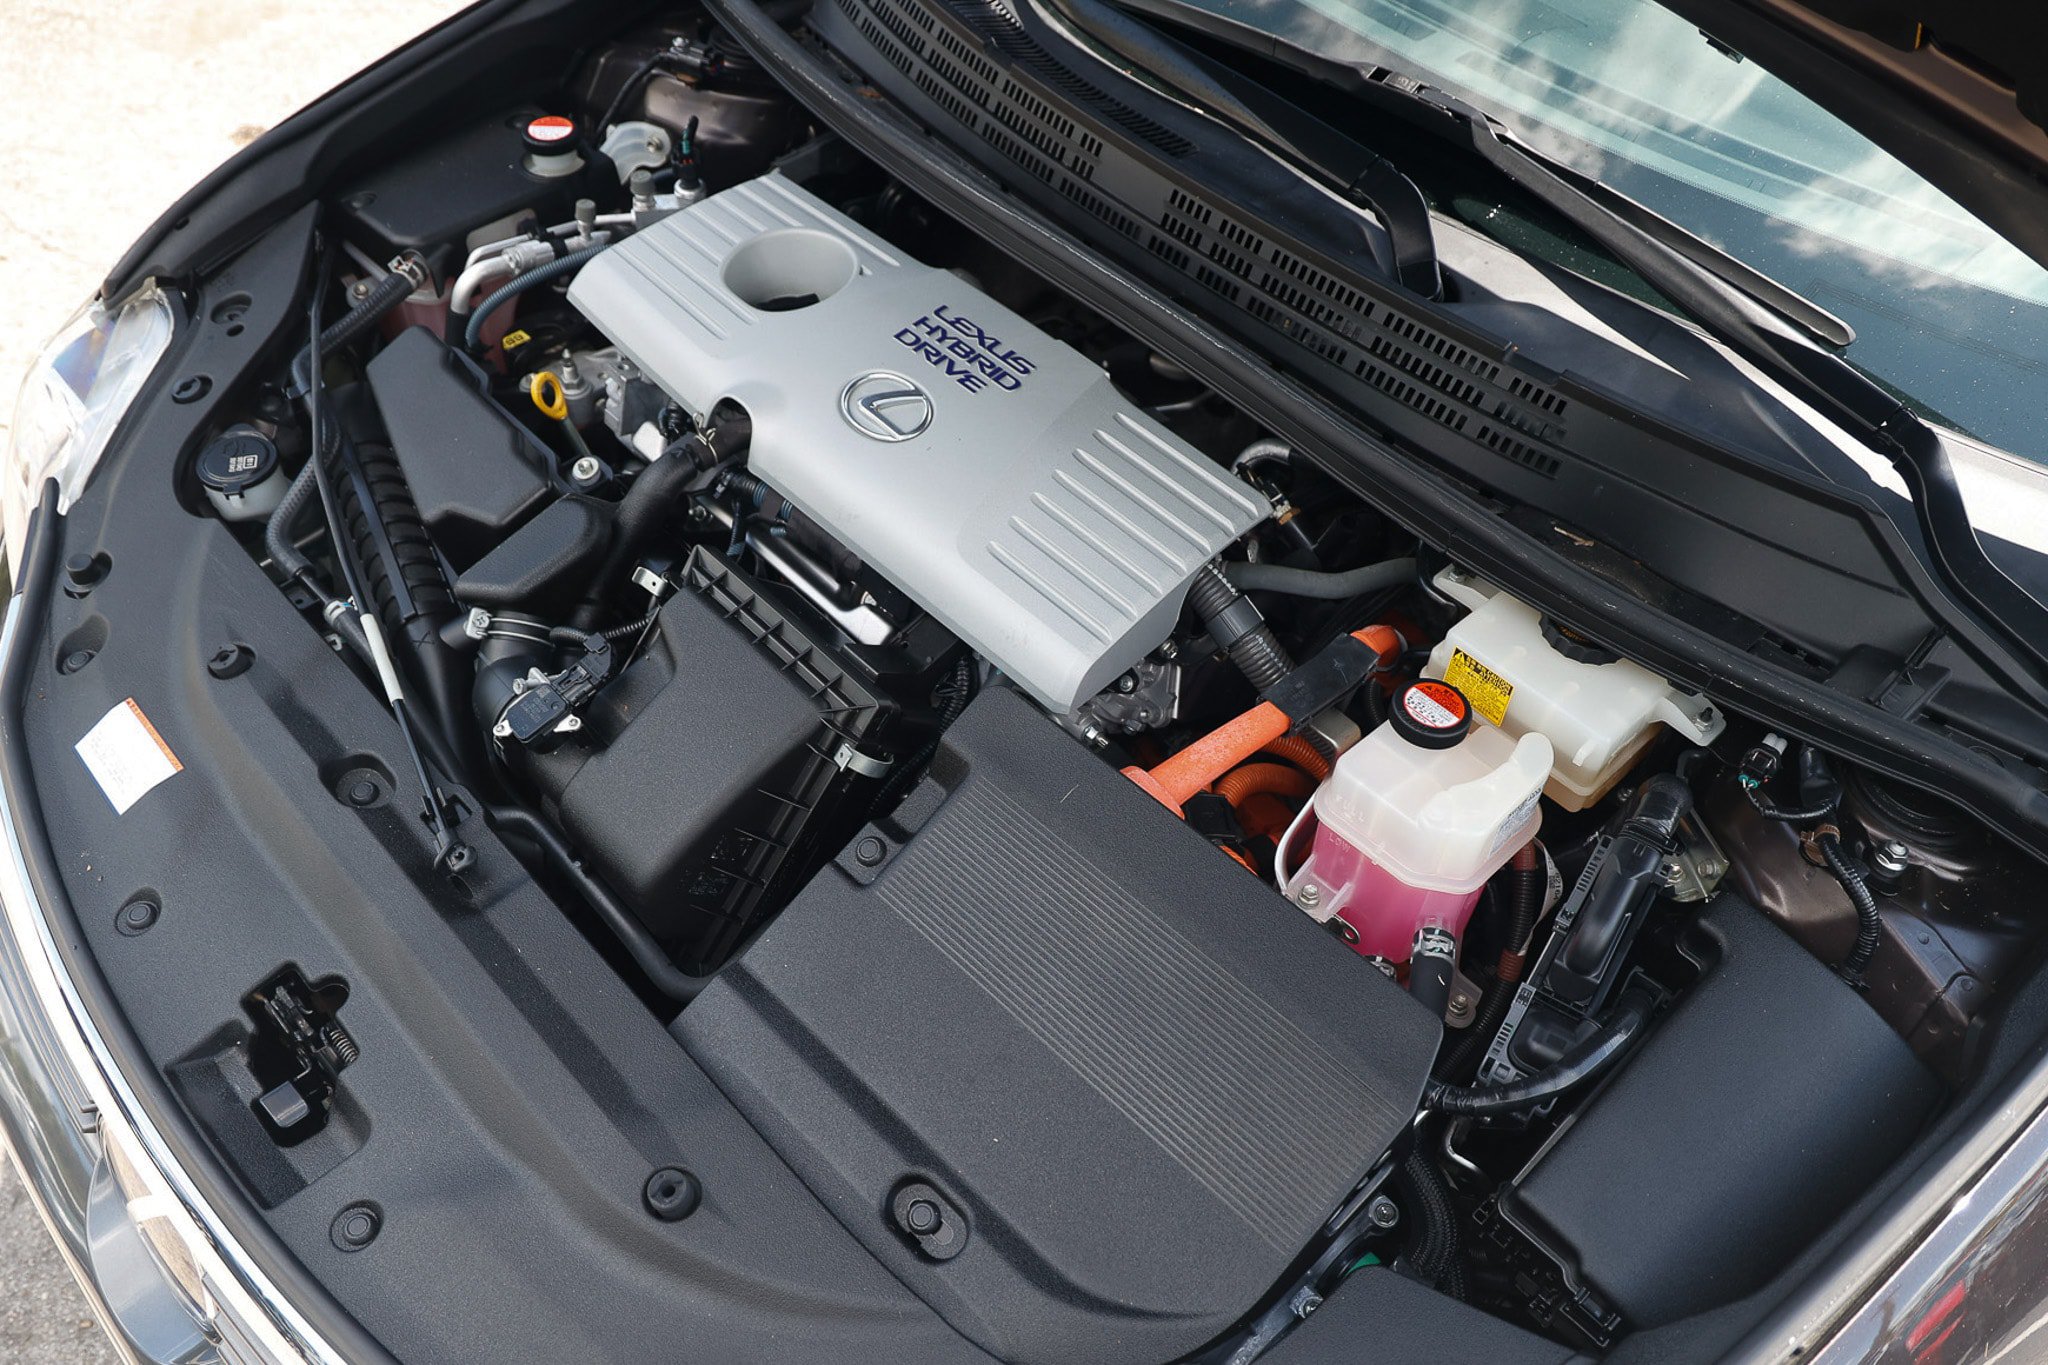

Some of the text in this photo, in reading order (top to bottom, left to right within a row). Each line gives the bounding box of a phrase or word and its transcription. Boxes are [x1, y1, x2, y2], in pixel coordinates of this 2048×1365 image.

[894, 328, 987, 393] DRIVE
[913, 316, 1021, 391] HYBRID
[934, 305, 1035, 374] LEXUS
